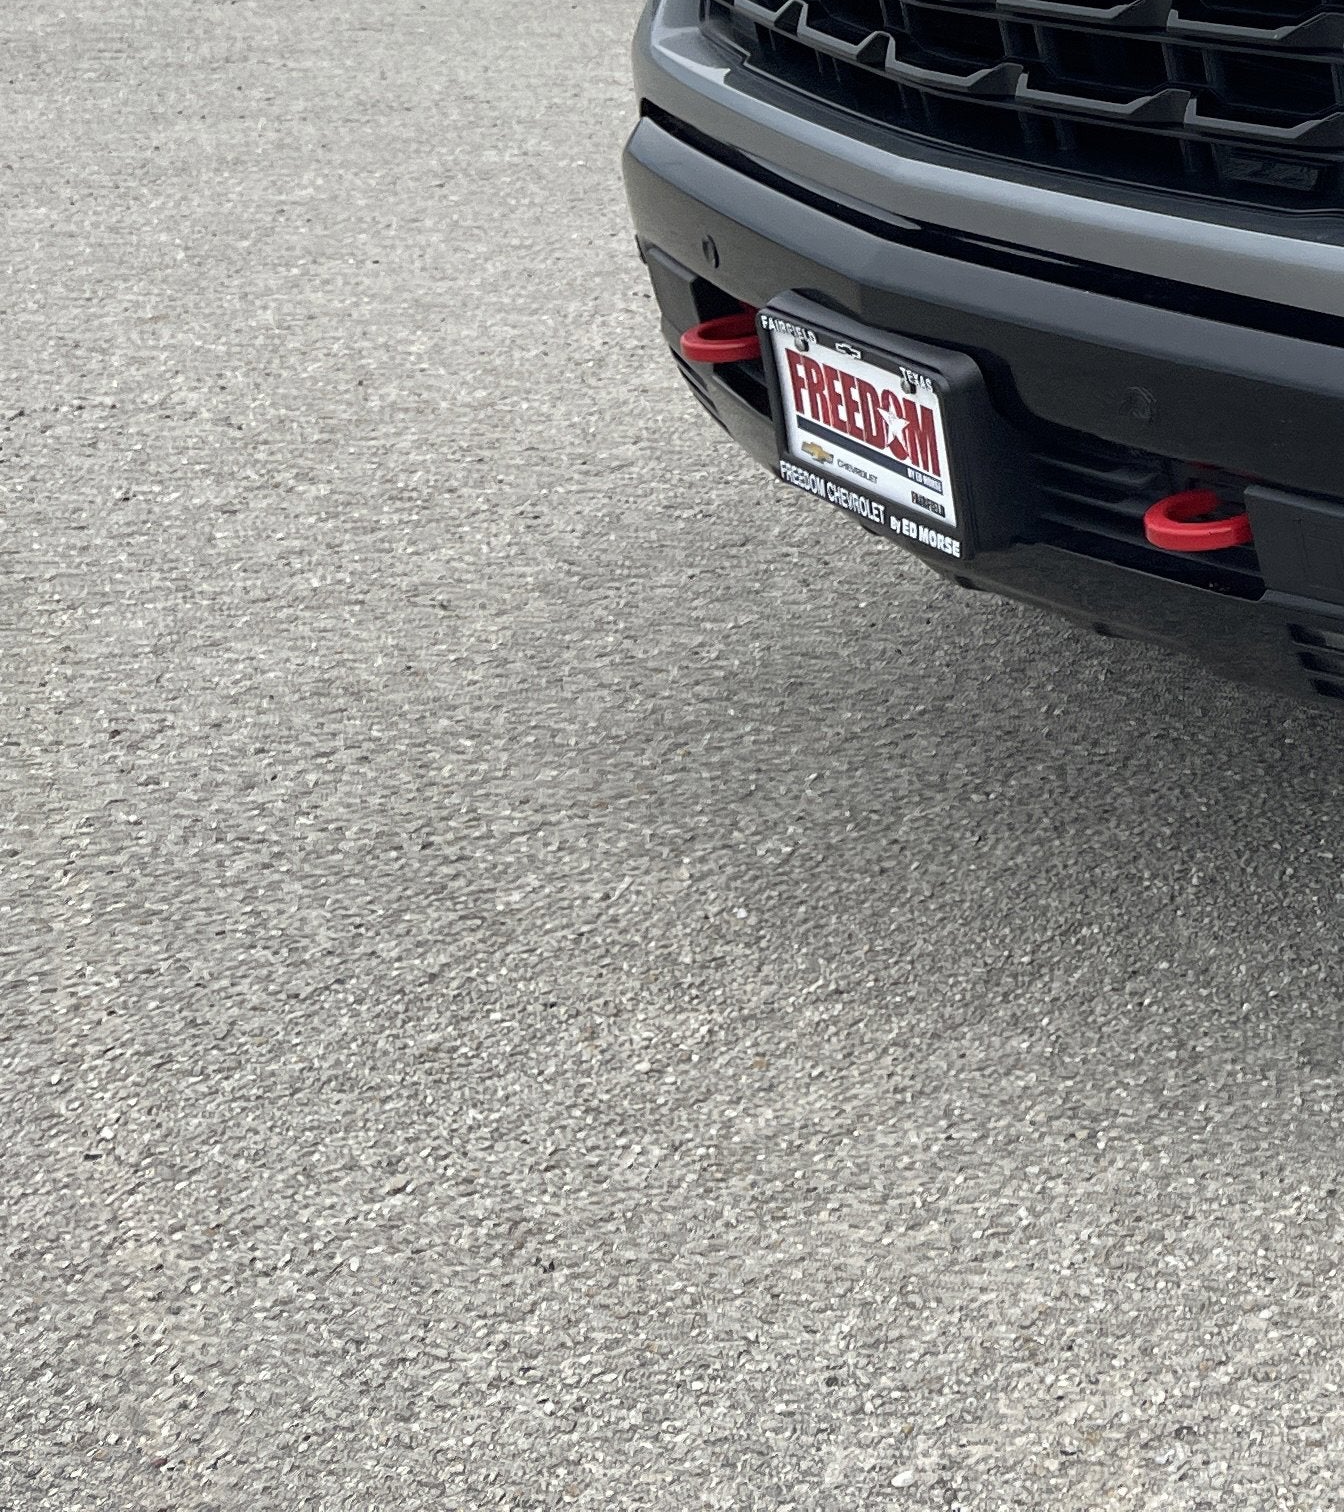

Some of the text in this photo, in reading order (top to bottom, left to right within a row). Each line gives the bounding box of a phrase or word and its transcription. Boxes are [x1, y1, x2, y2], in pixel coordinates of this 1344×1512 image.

[760, 315, 933, 393] FAIRFIELD TEXAS
[785, 348, 941, 478] FREEDOM
[780, 460, 826, 498] FREEDOM
[826, 481, 885, 525] CHEVROLET
[901, 518, 918, 539] ED
[918, 523, 961, 558] MORSE
[837, 459, 878, 484] CHEVROLET
